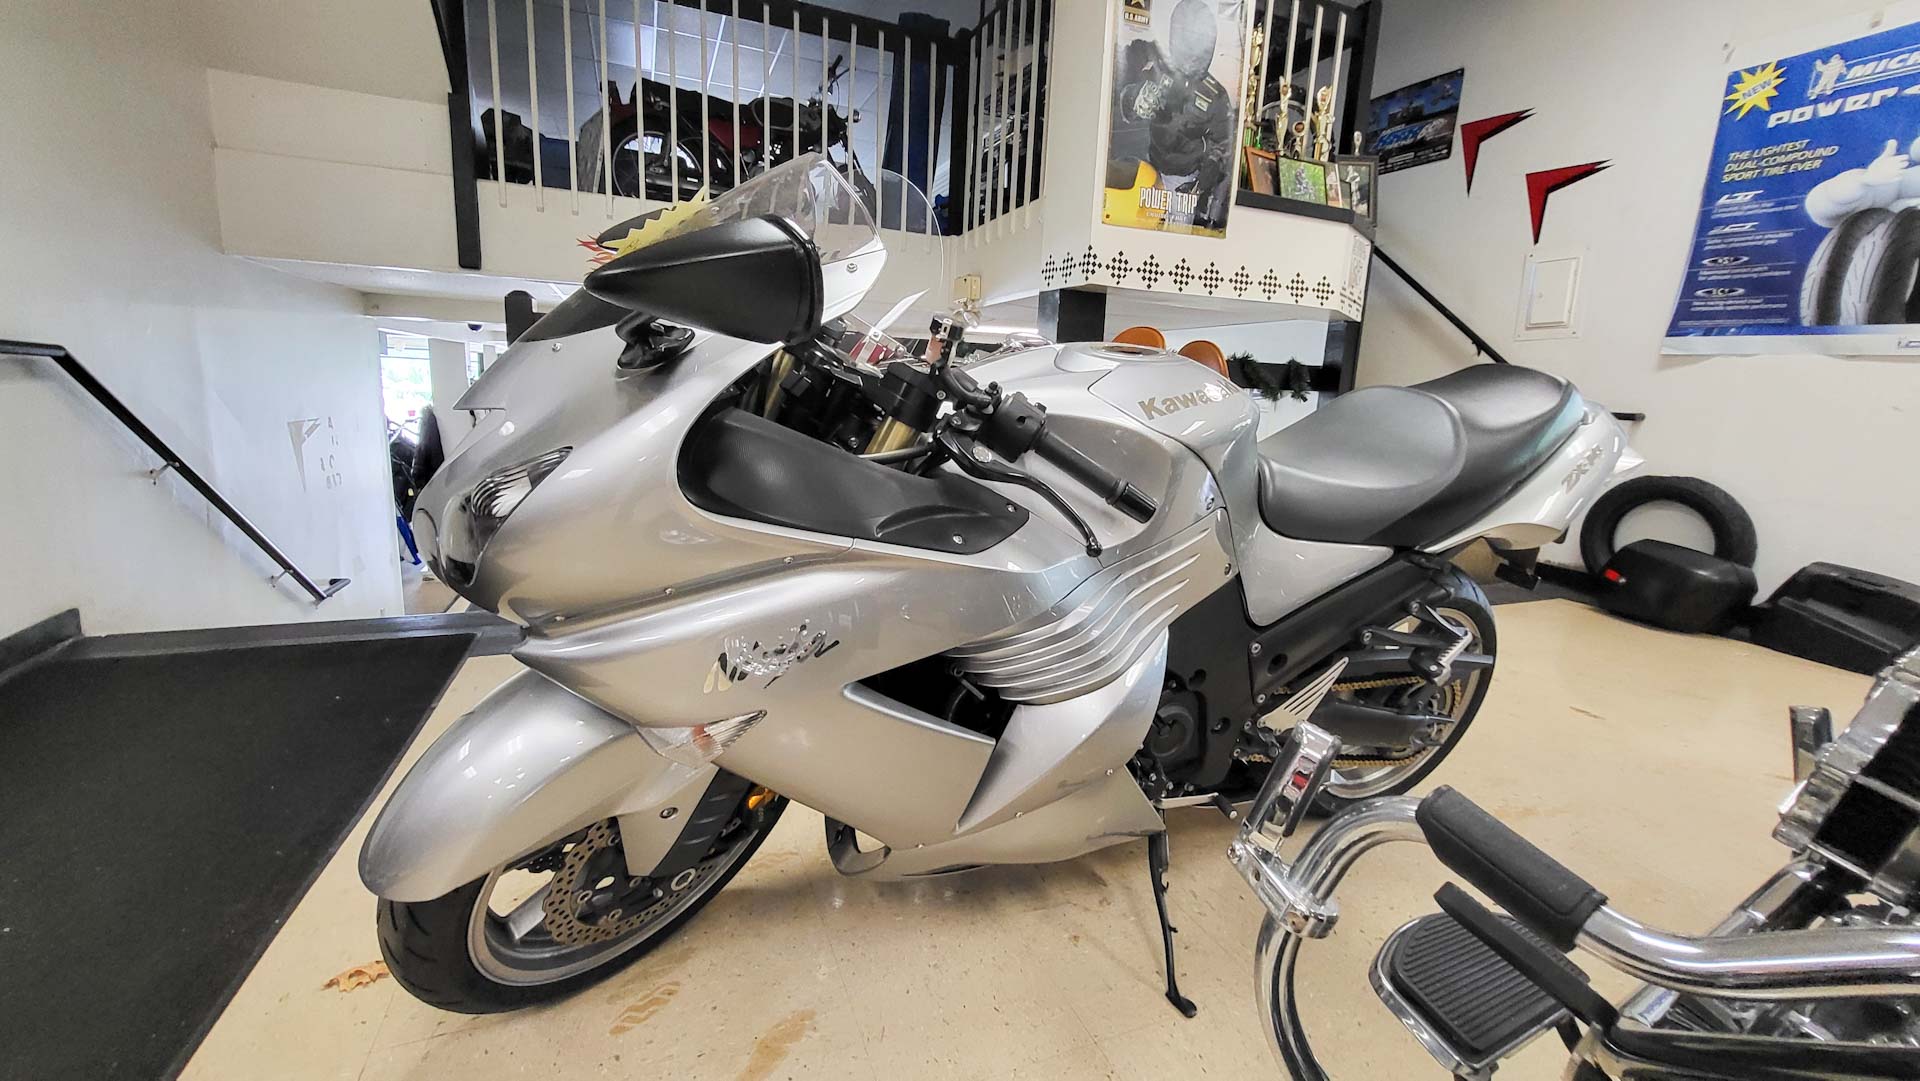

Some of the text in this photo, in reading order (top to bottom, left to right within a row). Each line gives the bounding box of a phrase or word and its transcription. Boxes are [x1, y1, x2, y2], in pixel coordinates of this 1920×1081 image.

[1742, 79, 1772, 99] NEW
[1724, 146, 1840, 172] DUAL-COMPOUND
[1728, 139, 1810, 161] THE LIGHTEST
[1721, 160, 1823, 183] SPORT TIRE EVER
[1139, 187, 1198, 214] POWER TRIP
[1138, 379, 1240, 420] Kawaaki
